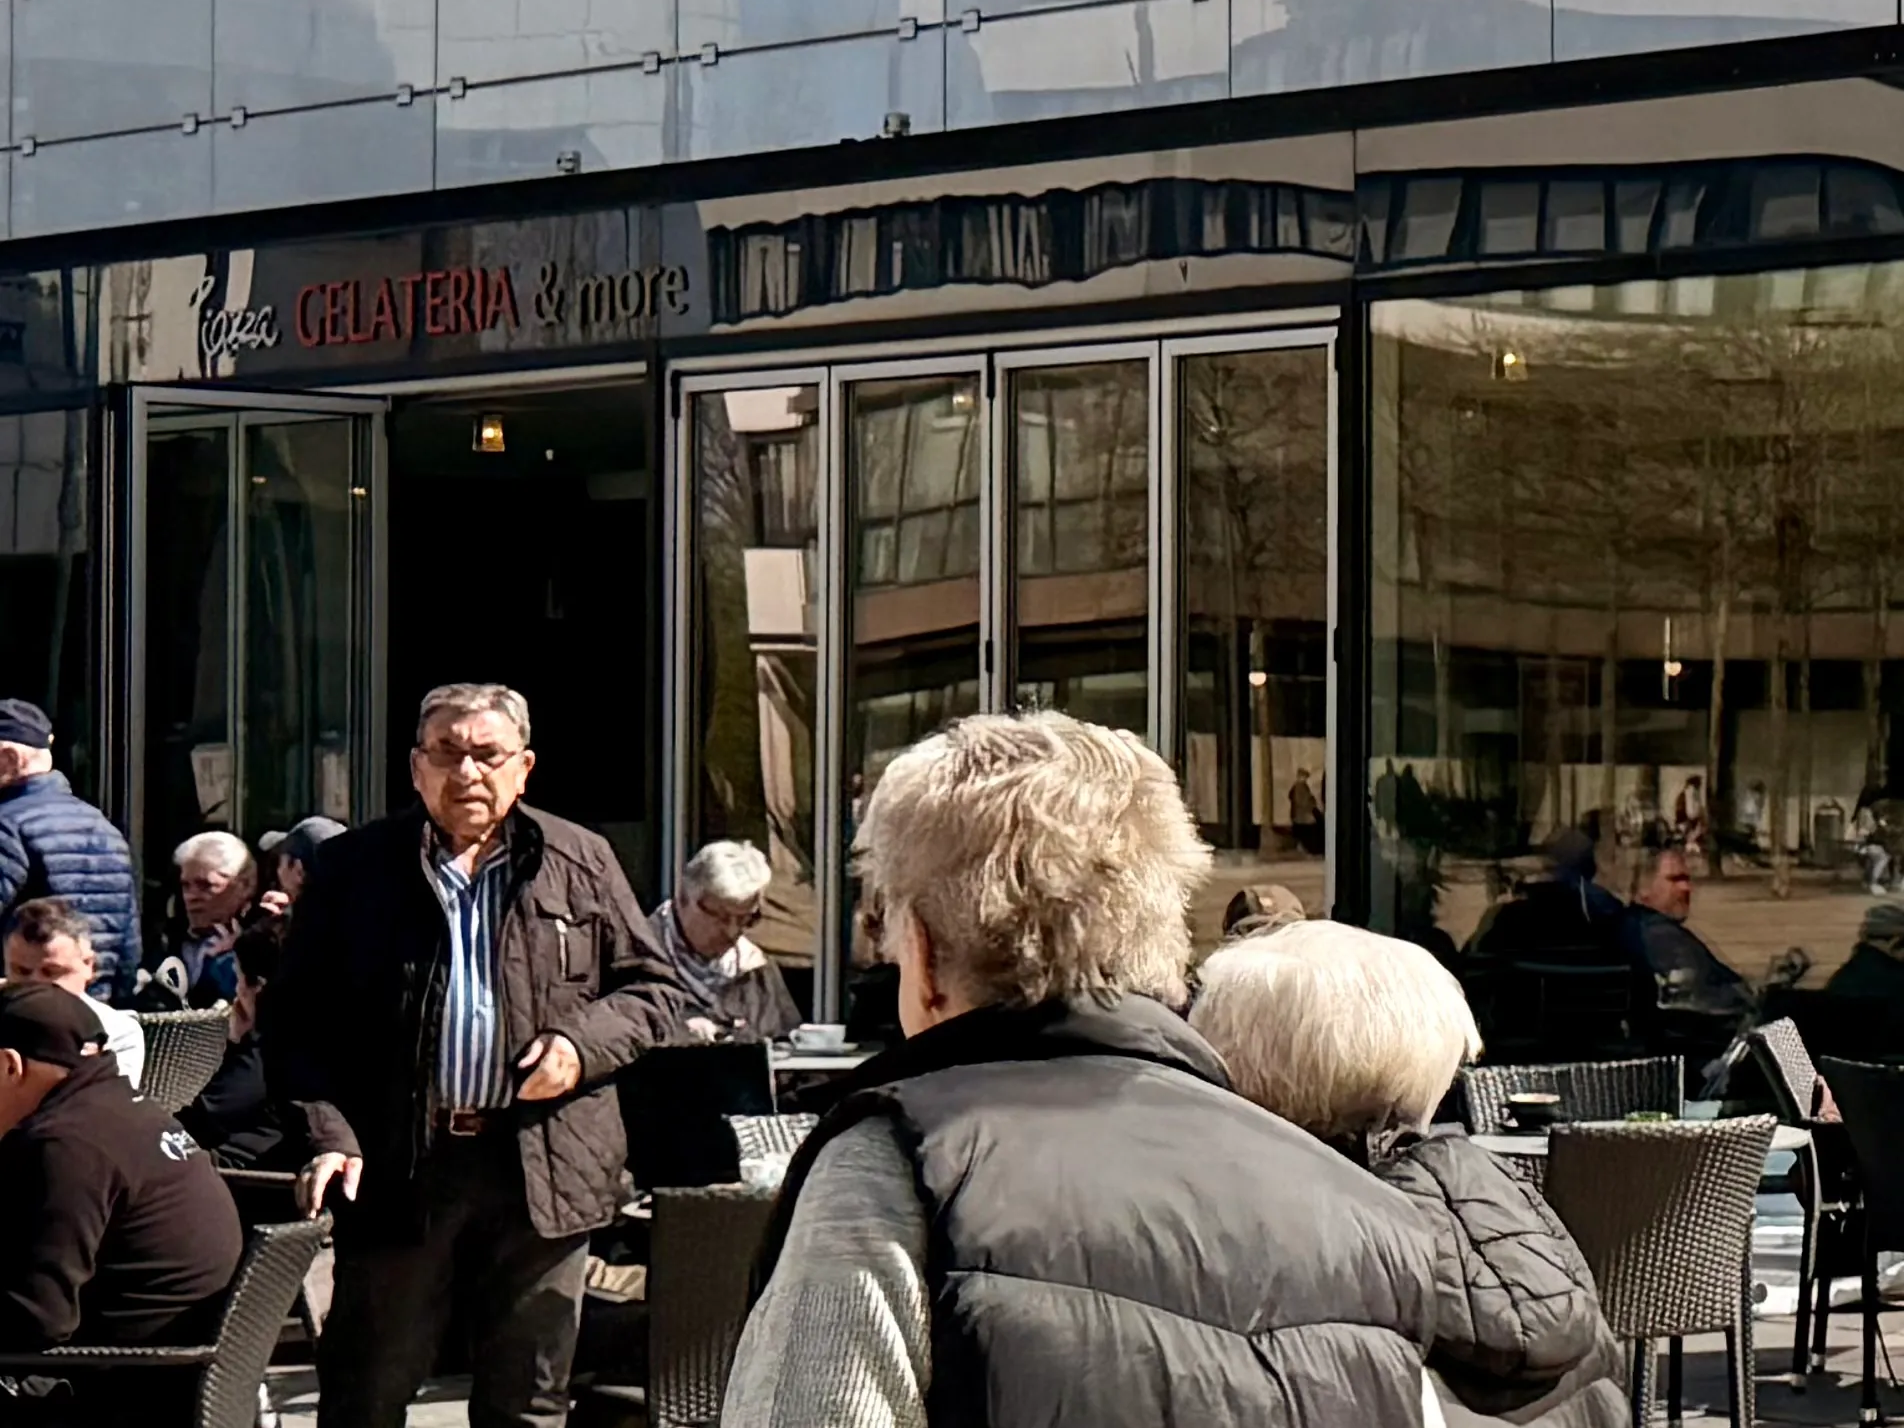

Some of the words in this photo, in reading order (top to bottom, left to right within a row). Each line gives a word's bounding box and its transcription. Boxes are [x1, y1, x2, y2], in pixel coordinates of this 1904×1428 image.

[295, 265, 520, 349] GELATERIA
[534, 261, 566, 327] &
[575, 264, 691, 329] more
